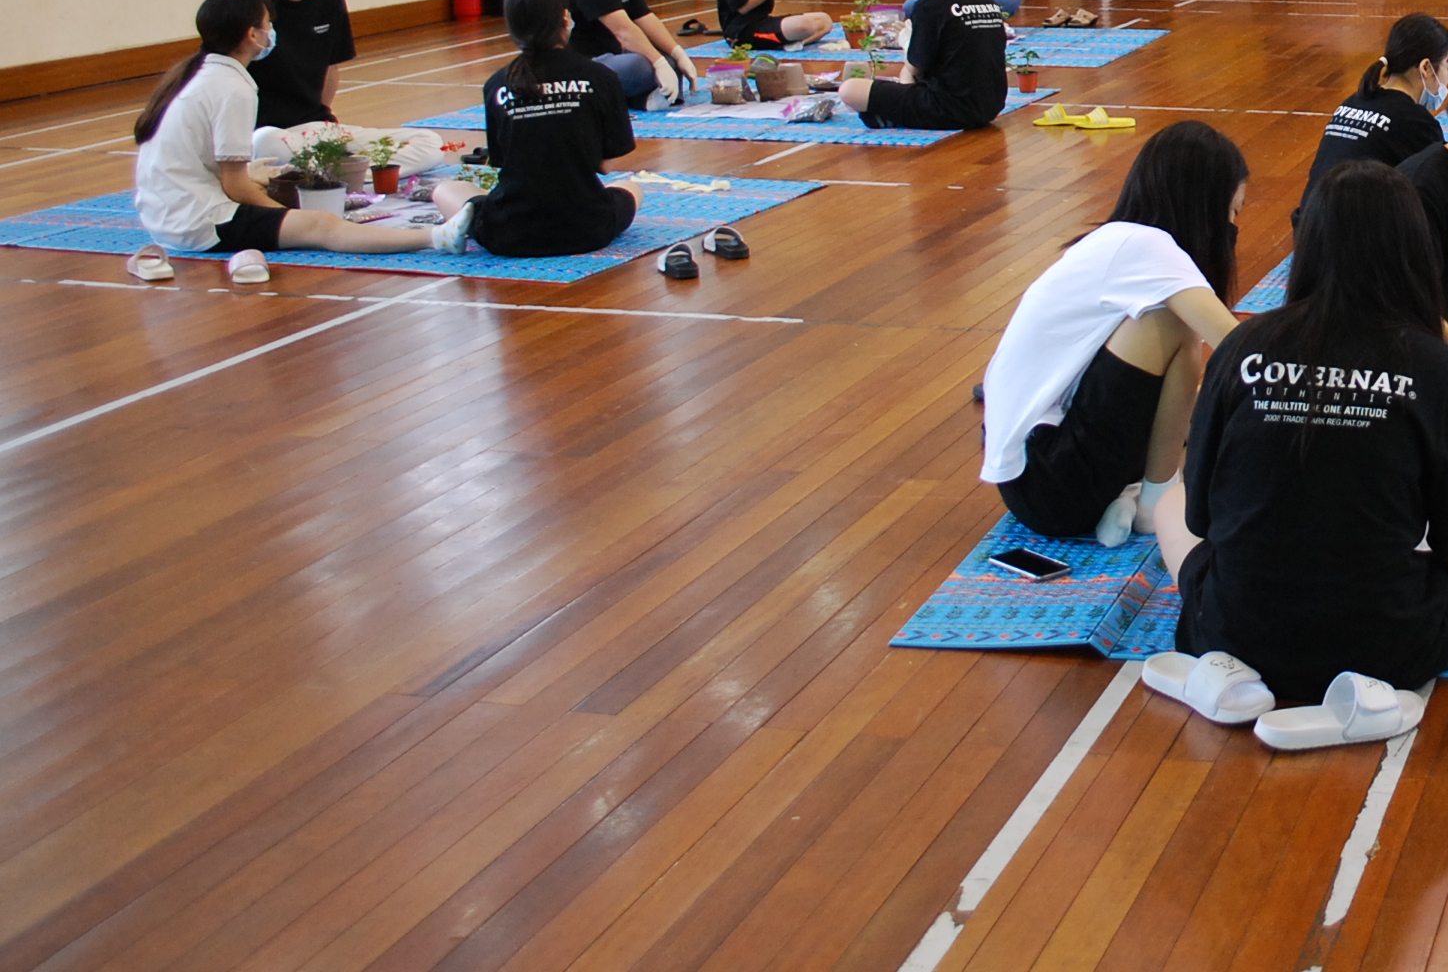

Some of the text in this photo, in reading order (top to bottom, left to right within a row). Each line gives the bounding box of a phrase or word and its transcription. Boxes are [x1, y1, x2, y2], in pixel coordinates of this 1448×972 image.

[497, 80, 590, 105] CRNAT
[1334, 105, 1392, 128] OVERNAT
[1252, 386, 1392, 404] AUTHENTIC
[1254, 400, 1388, 418] THE MULTITUE ONE ATTITUDE
[1282, 414, 1326, 425] TRADEARK
